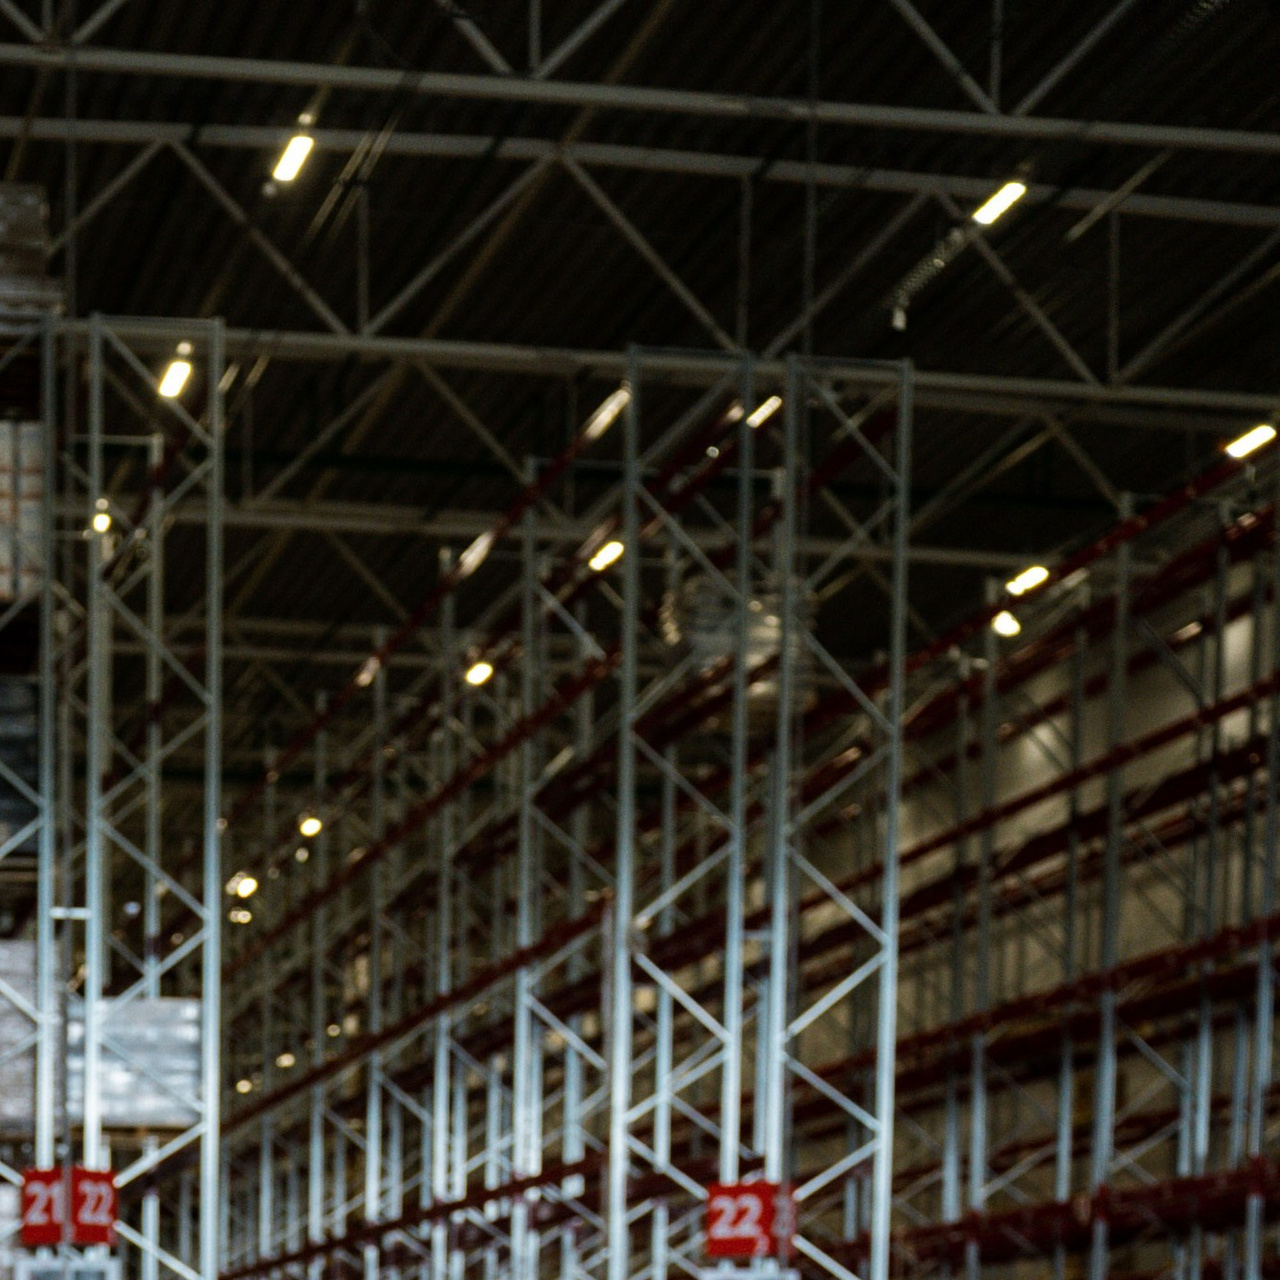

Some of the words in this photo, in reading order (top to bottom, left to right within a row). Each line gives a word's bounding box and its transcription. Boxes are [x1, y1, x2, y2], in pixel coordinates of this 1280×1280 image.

[24, 1180, 64, 1226] 21
[77, 1180, 113, 1226] 22
[709, 1193, 764, 1240] 22
